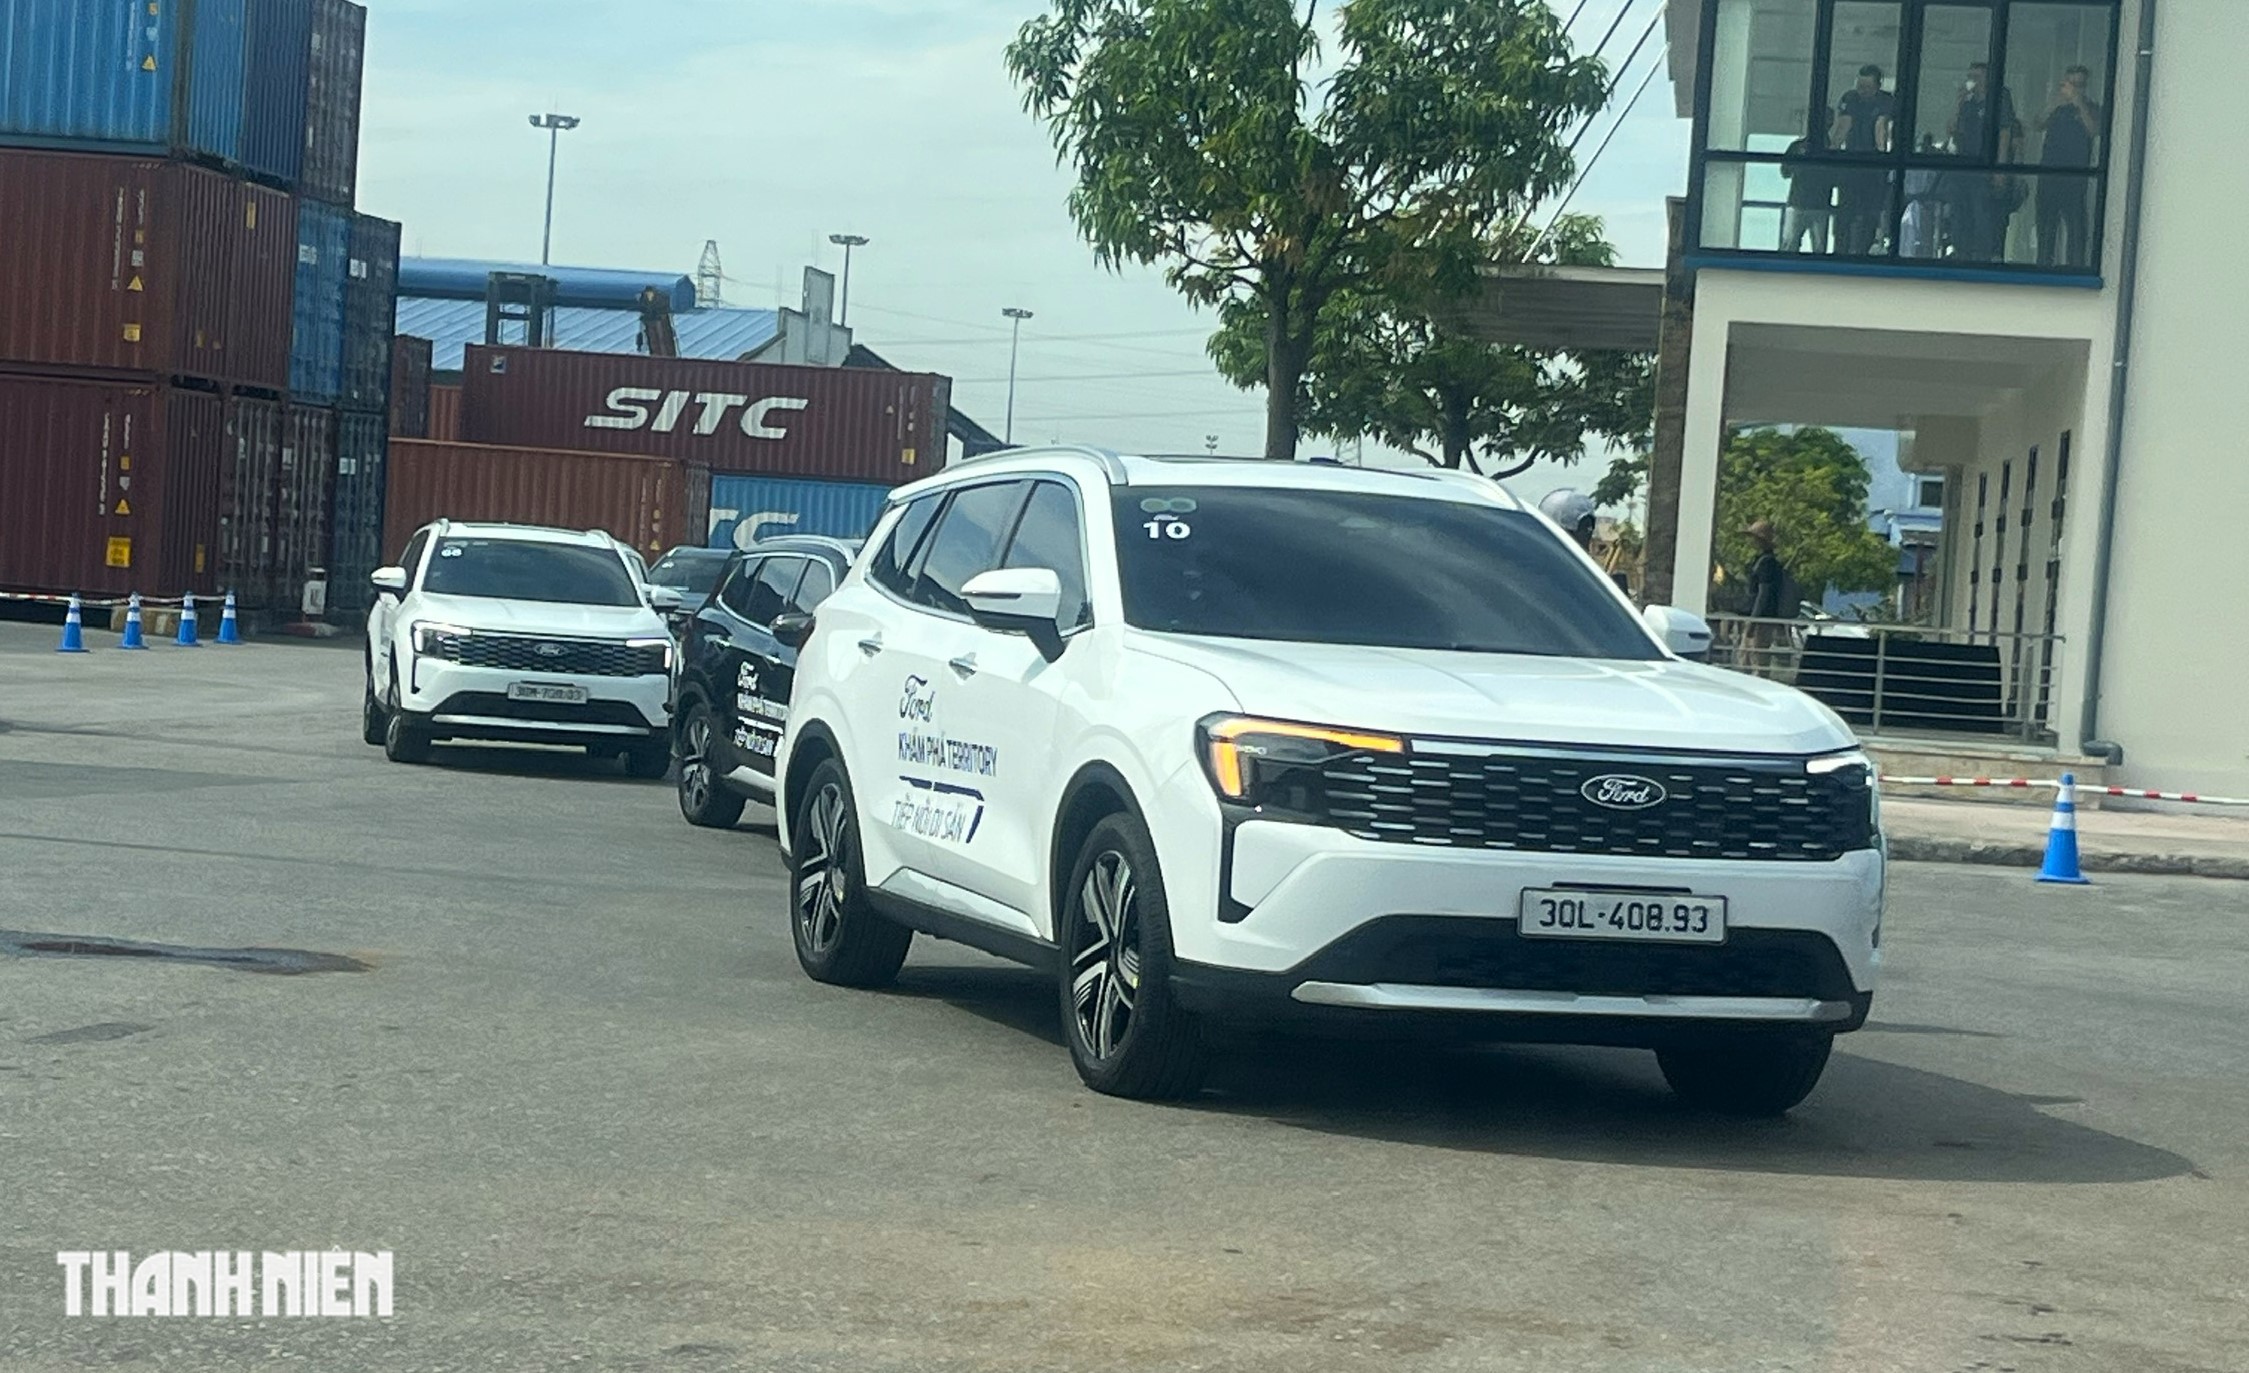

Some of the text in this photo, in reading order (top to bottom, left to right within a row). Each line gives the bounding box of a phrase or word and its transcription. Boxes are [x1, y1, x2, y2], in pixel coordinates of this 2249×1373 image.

[584, 386, 808, 440] SITC
[1143, 521, 1191, 539] 10
[899, 674, 936, 723] Ford
[898, 727, 926, 763] KHÁM
[946, 739, 998, 777] TERRITORY
[1597, 778, 1651, 803] Ford
[1538, 899, 1709, 934] 30L-408.93
